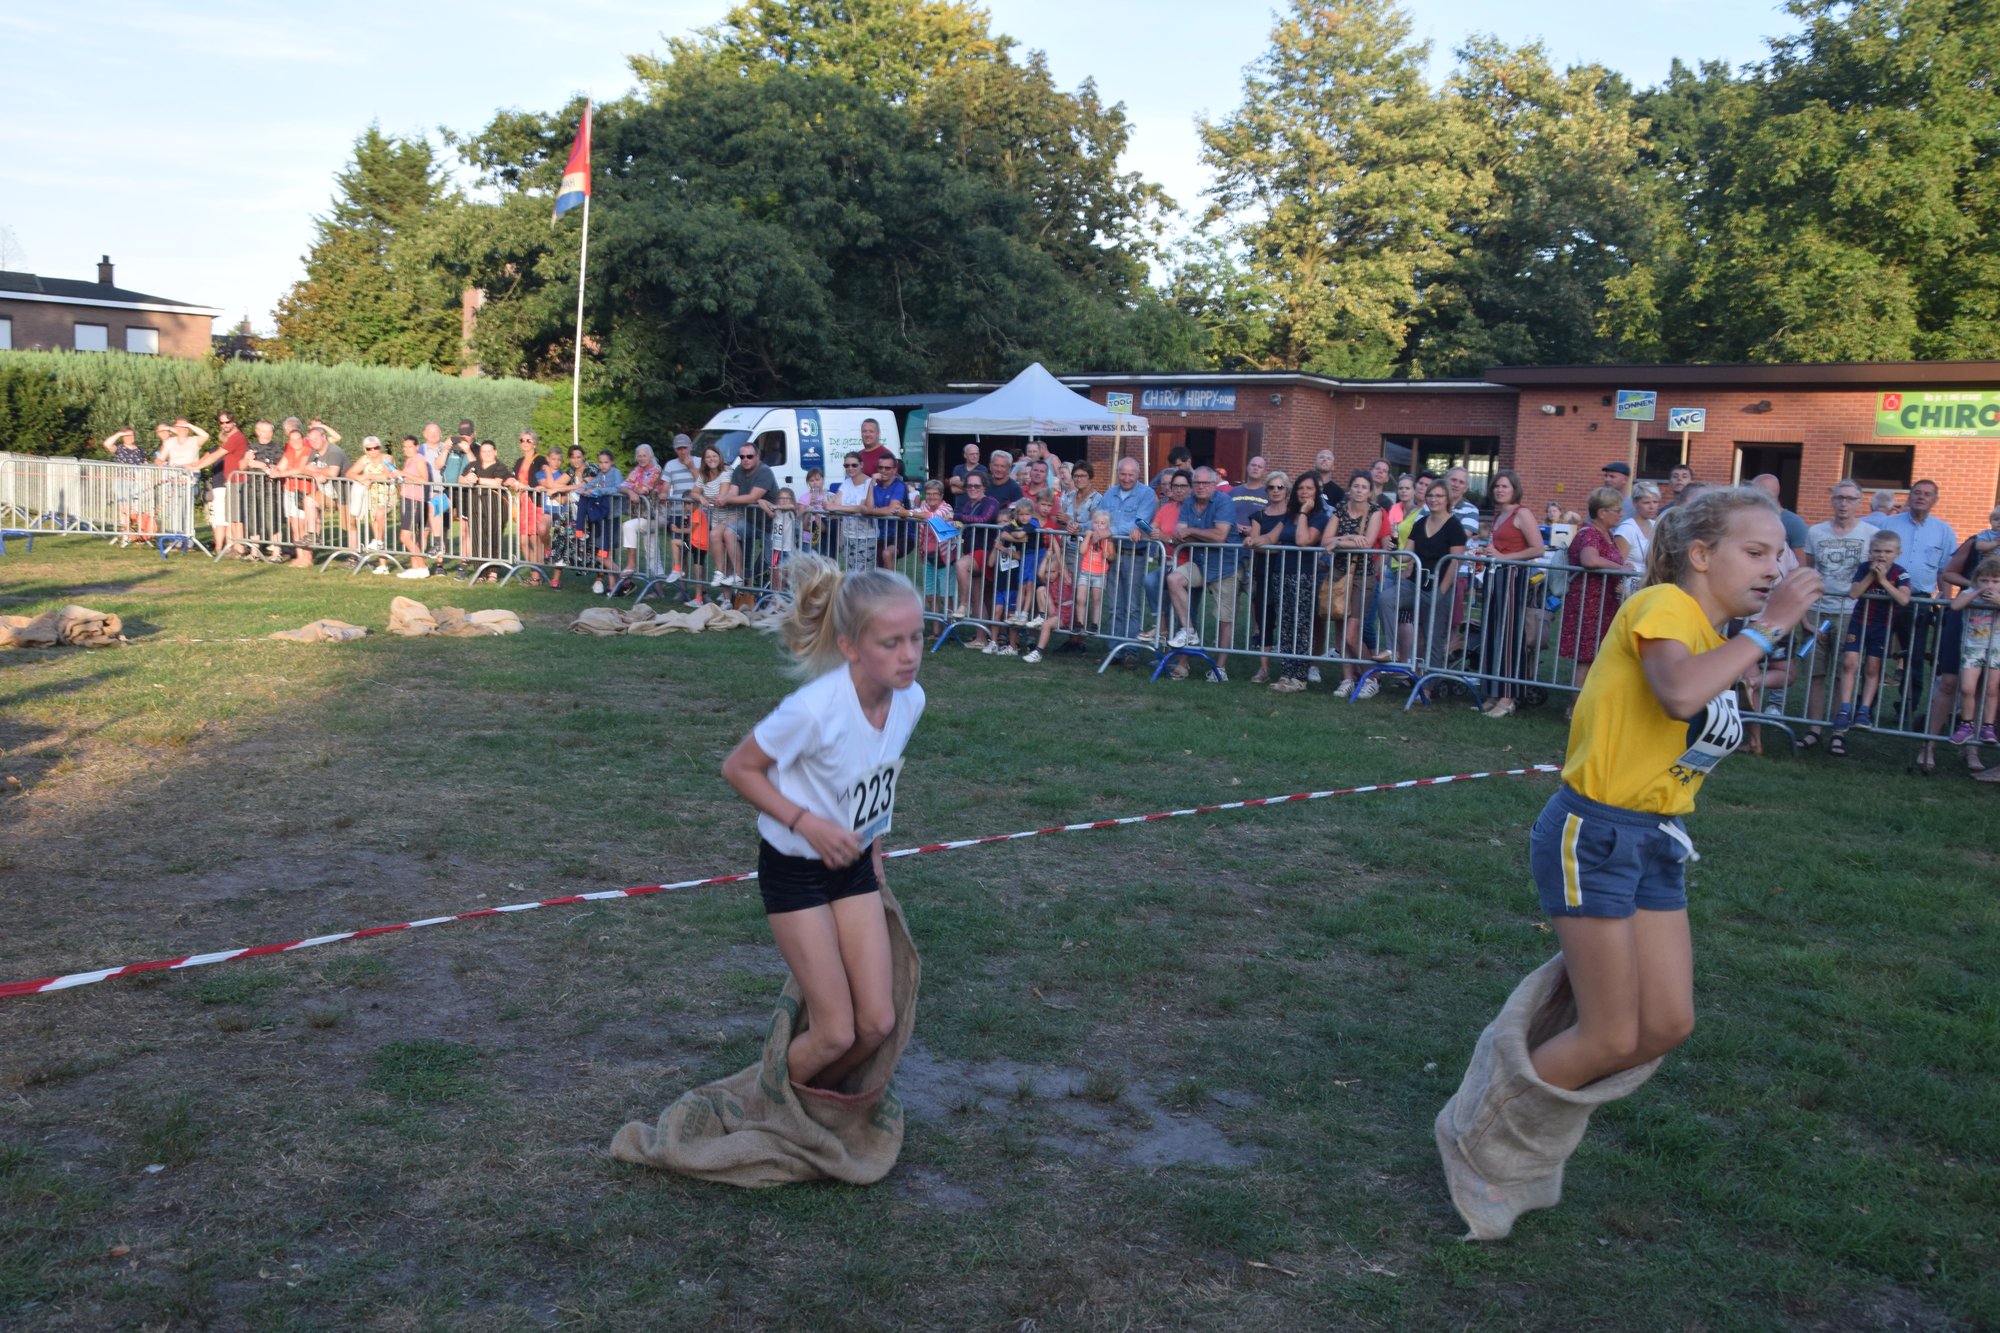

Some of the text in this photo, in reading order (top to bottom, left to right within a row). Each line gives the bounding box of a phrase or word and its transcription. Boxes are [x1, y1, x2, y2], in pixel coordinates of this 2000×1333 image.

[1108, 397, 1132, 408] TOOG
[1618, 399, 1655, 411] BONNEN
[1674, 412, 1701, 427] WC
[800, 418, 819, 437] 50
[853, 767, 895, 832] 223
